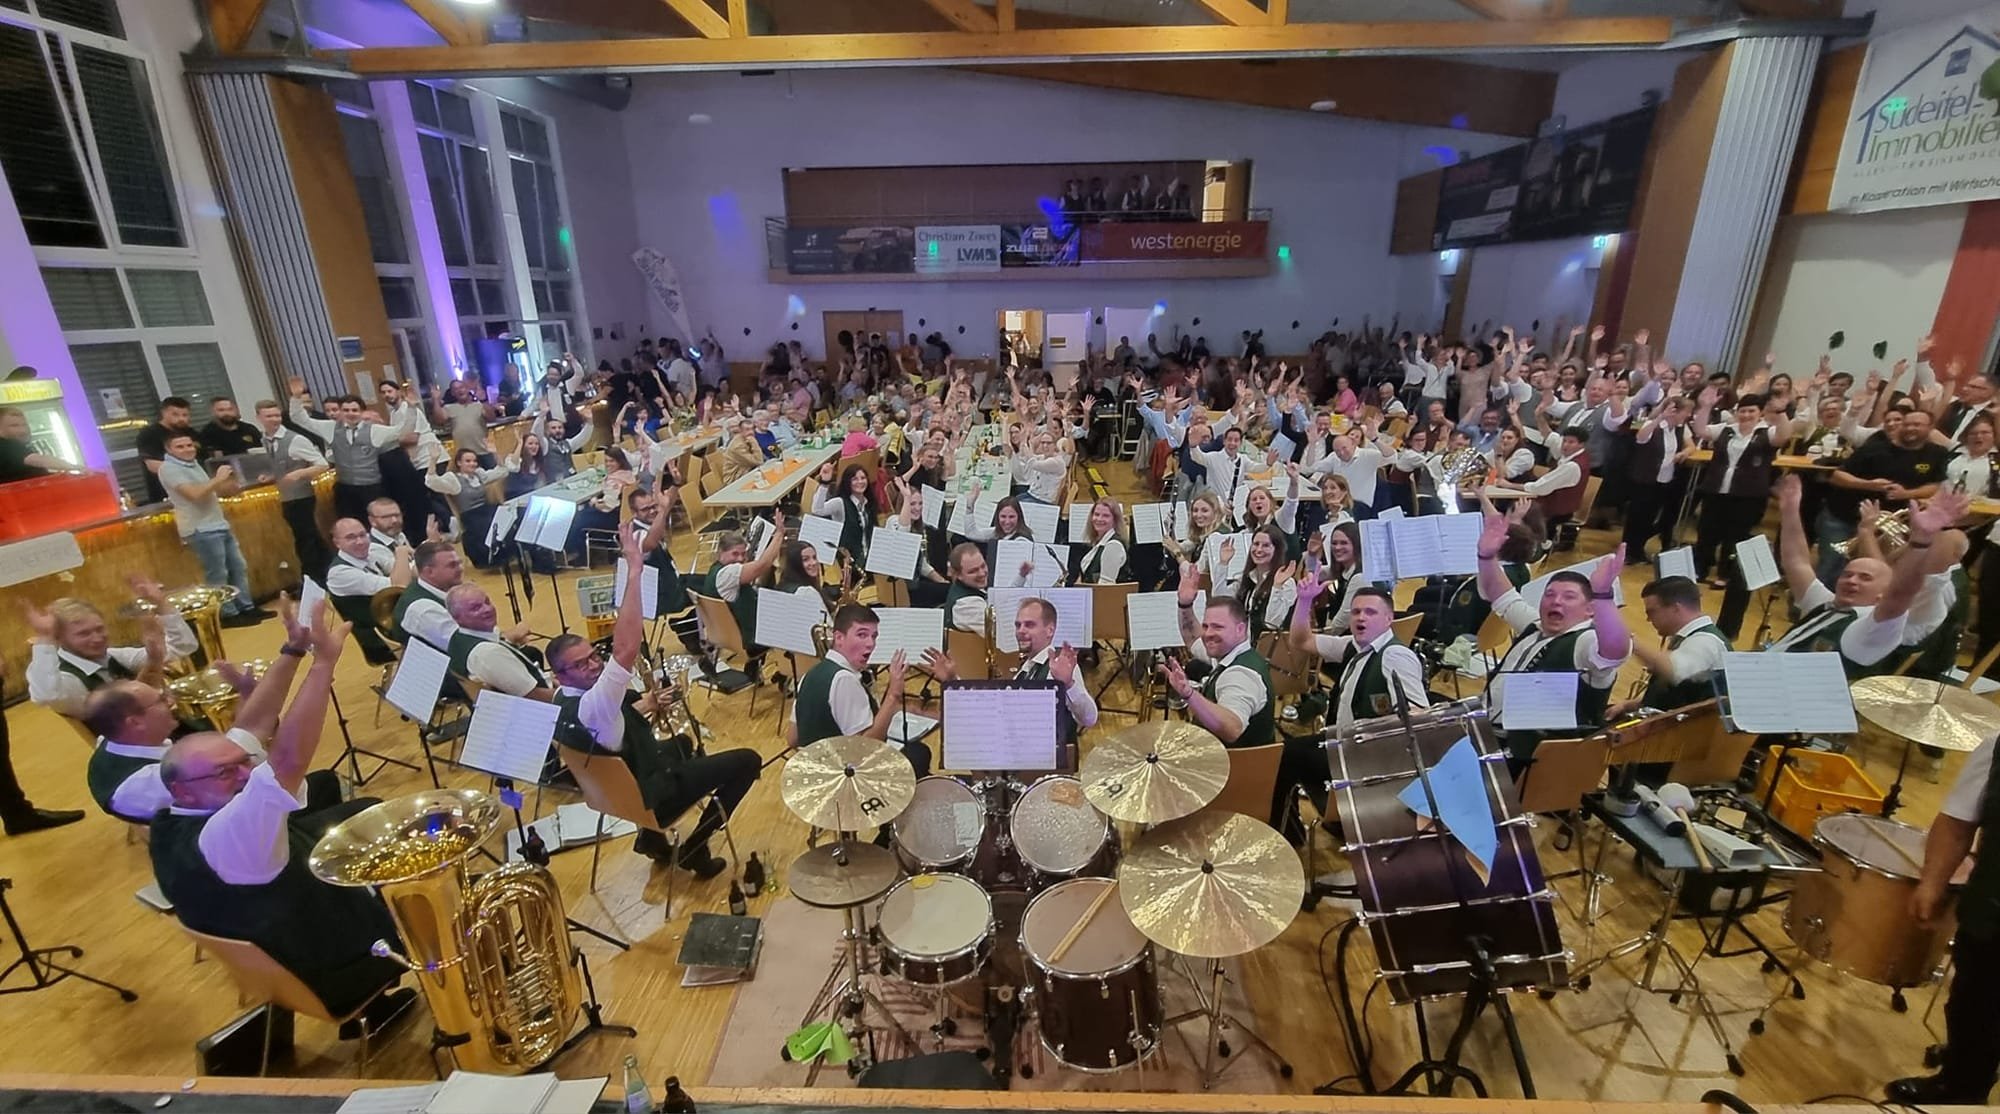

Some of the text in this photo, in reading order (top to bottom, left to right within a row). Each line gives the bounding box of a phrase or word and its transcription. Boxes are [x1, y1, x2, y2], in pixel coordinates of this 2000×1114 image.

[1874, 82, 1984, 132] Südeifel-
[1868, 112, 2000, 162] Immobilie
[918, 230, 965, 242] Christian
[1131, 230, 1242, 253] westenergie
[957, 247, 983, 262] LVM
